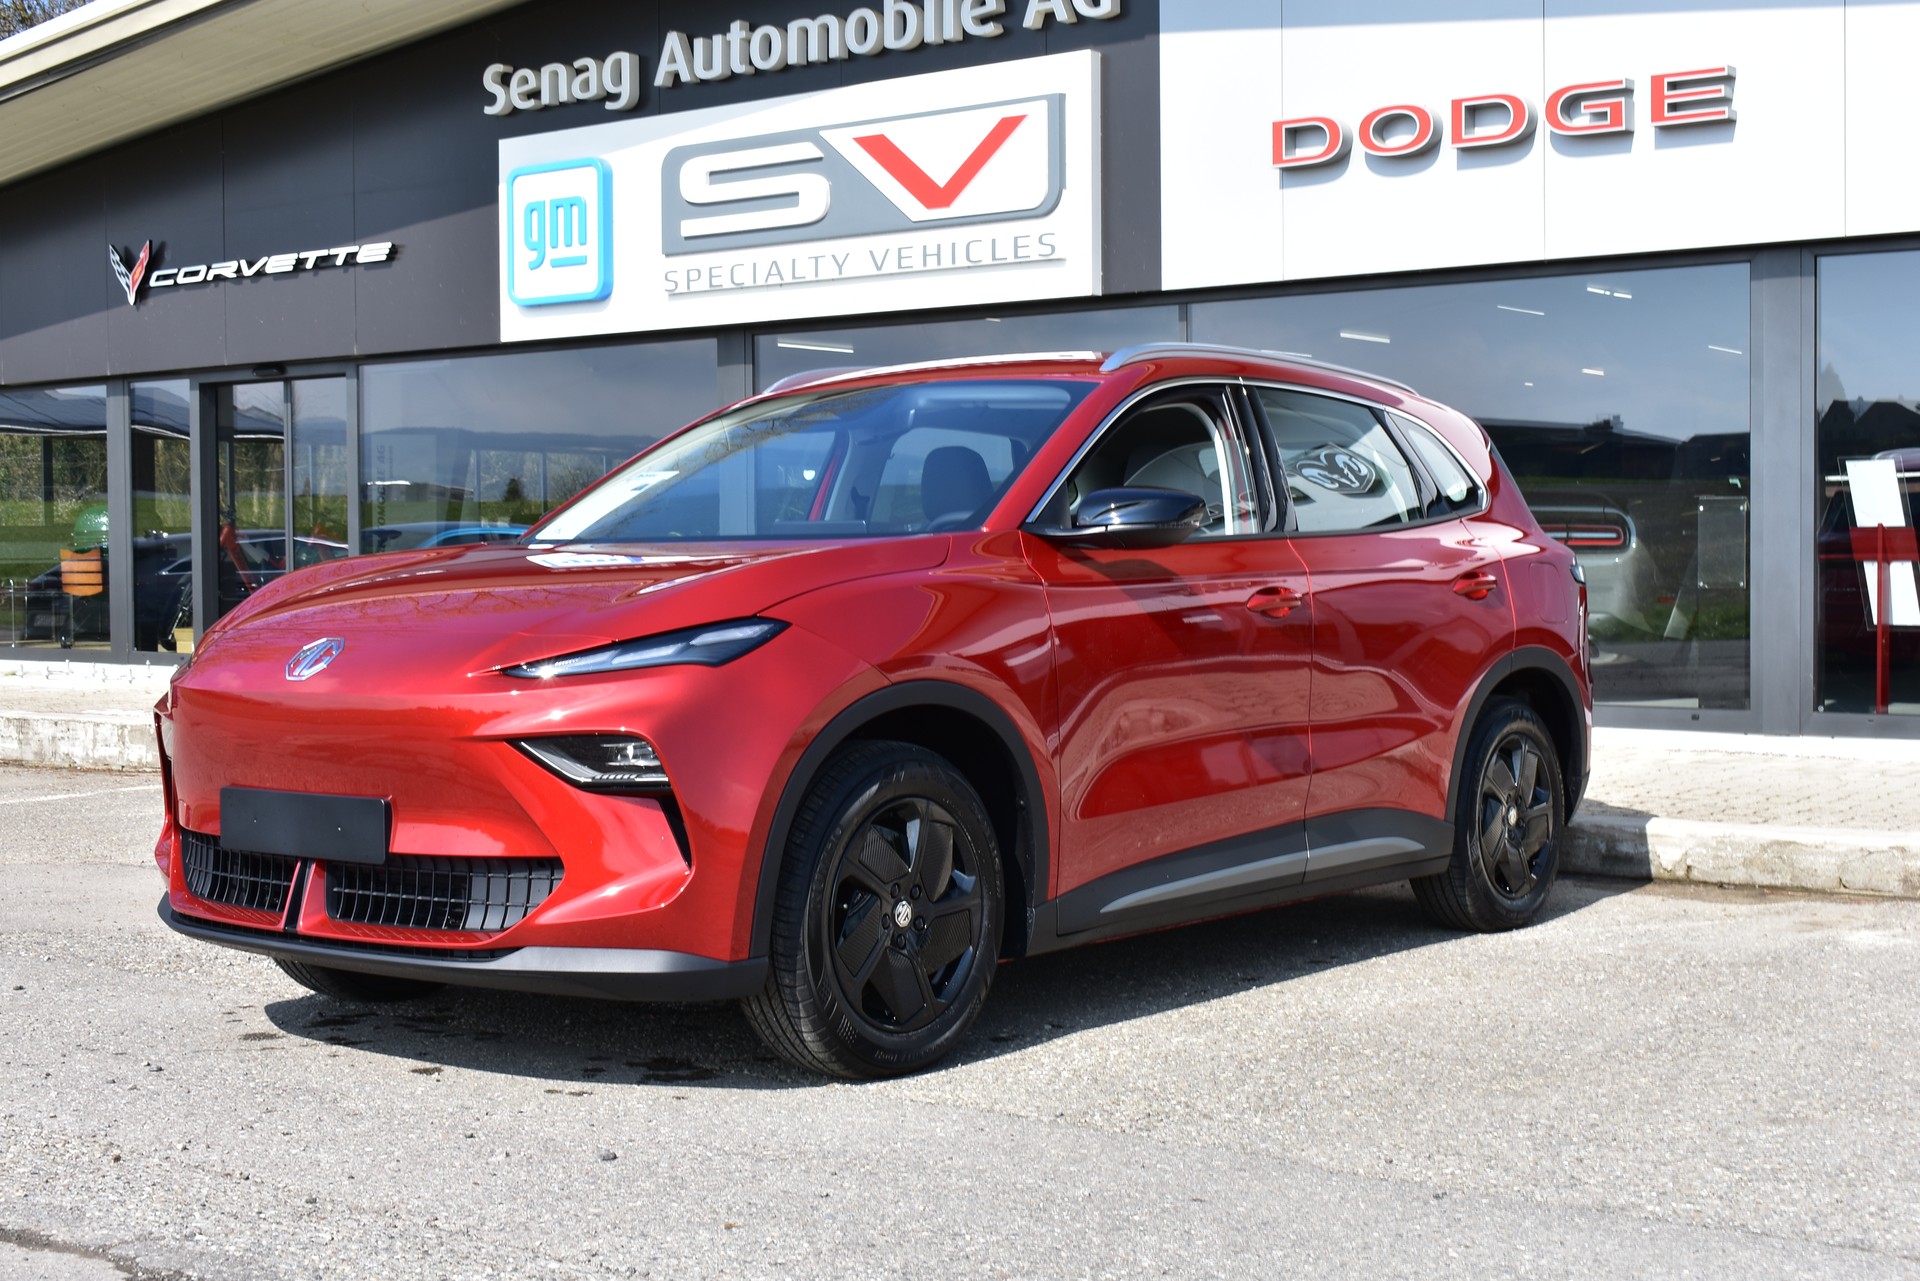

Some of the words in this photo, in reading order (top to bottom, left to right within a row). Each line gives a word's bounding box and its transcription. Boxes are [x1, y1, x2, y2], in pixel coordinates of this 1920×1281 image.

[483, 51, 639, 116] Senag
[654, 0, 1006, 87] Automobile
[1272, 65, 1736, 169] DODGE
[150, 242, 392, 287] CORVETTE
[524, 196, 587, 270] gm
[664, 253, 850, 292] SPECIALTY
[869, 232, 1056, 272] VEHICLES
